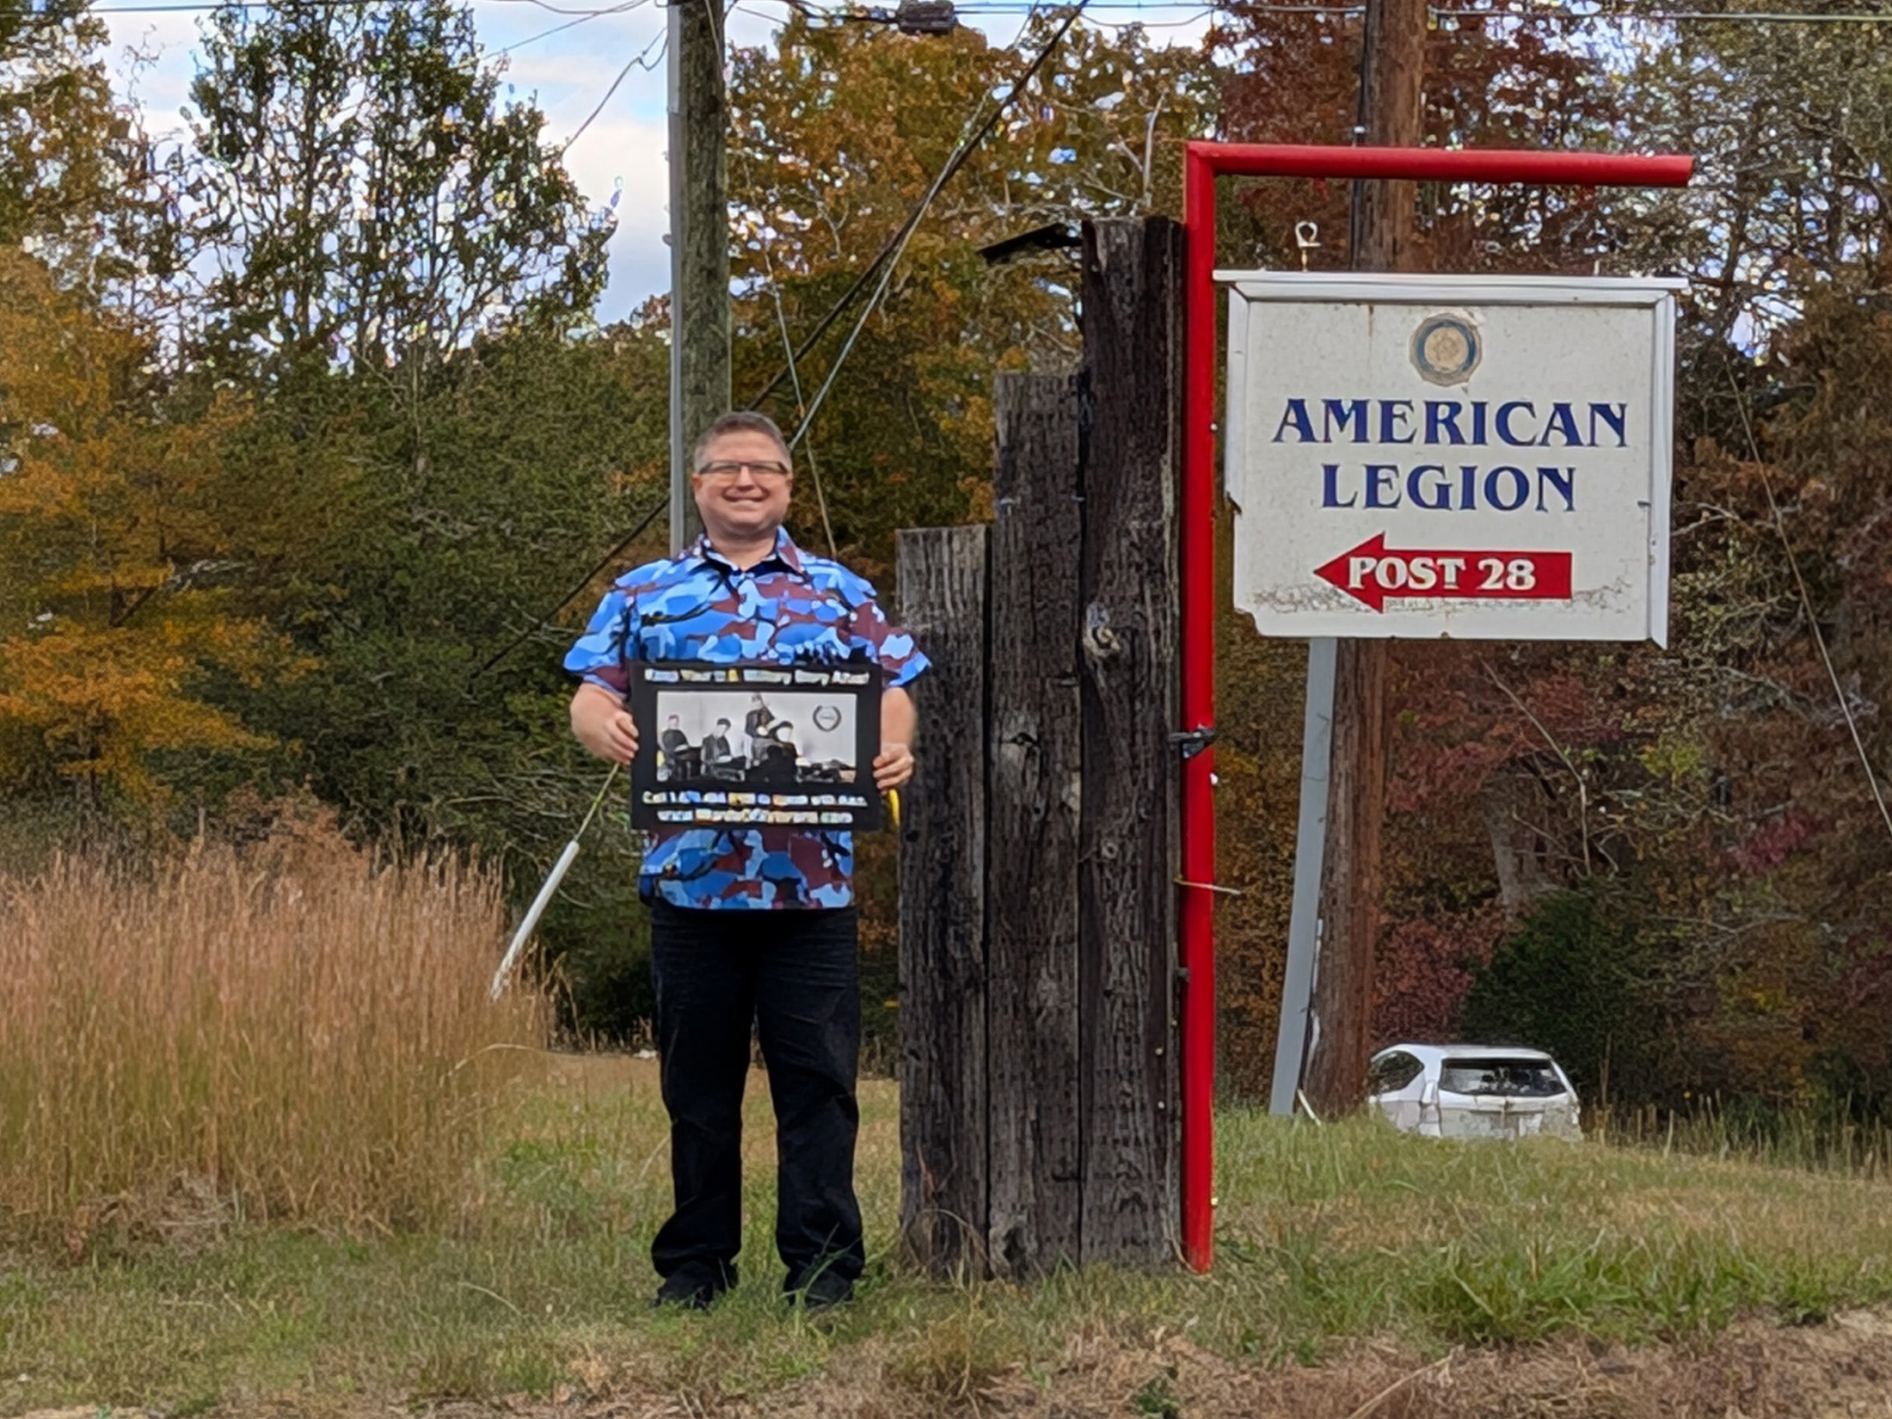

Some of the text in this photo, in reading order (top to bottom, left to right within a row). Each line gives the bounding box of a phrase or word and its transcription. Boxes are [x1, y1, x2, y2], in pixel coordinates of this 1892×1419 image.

[1273, 398, 1628, 448] AMERICAN
[1322, 464, 1575, 512] LEGION
[1348, 557, 1536, 590] POST 28
